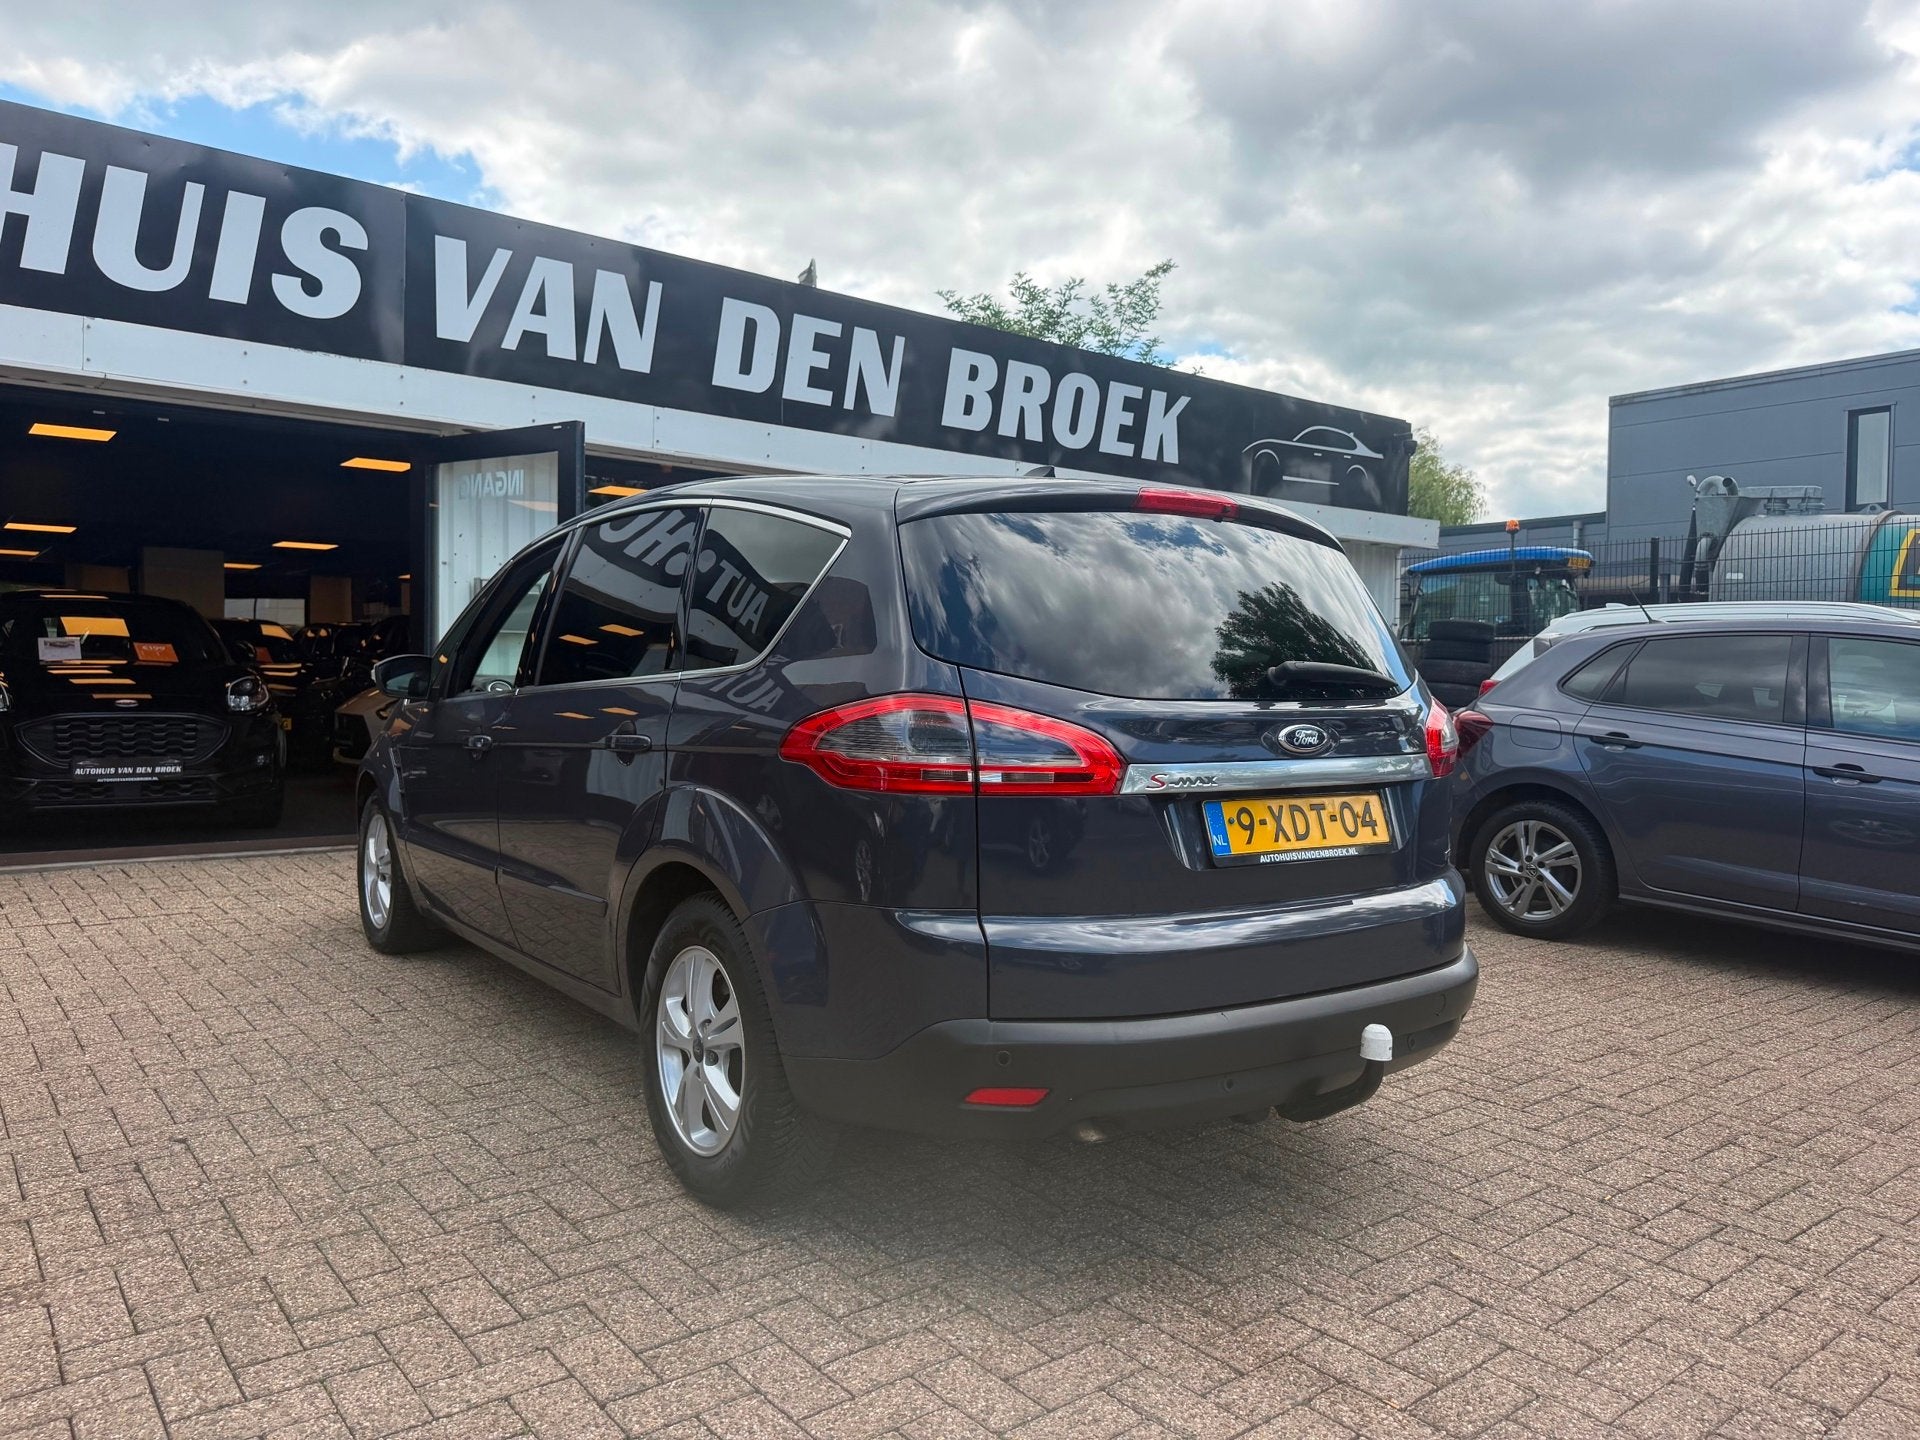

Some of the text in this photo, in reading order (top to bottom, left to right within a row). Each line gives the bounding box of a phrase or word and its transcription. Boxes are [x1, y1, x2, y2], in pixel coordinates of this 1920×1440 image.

[434, 235, 663, 374] VAN
[712, 297, 906, 417] DEN
[942, 347, 1191, 464] BROEK
[1293, 729, 1319, 745] Ford
[74, 767, 116, 775] AUTOHUIS
[136, 766, 152, 774] DEN
[155, 765, 182, 773] BROEK
[1213, 801, 1378, 847] NL 9-XDT-04
[1259, 847, 1359, 864] AUTOHUISVANDENBROEK.NL
